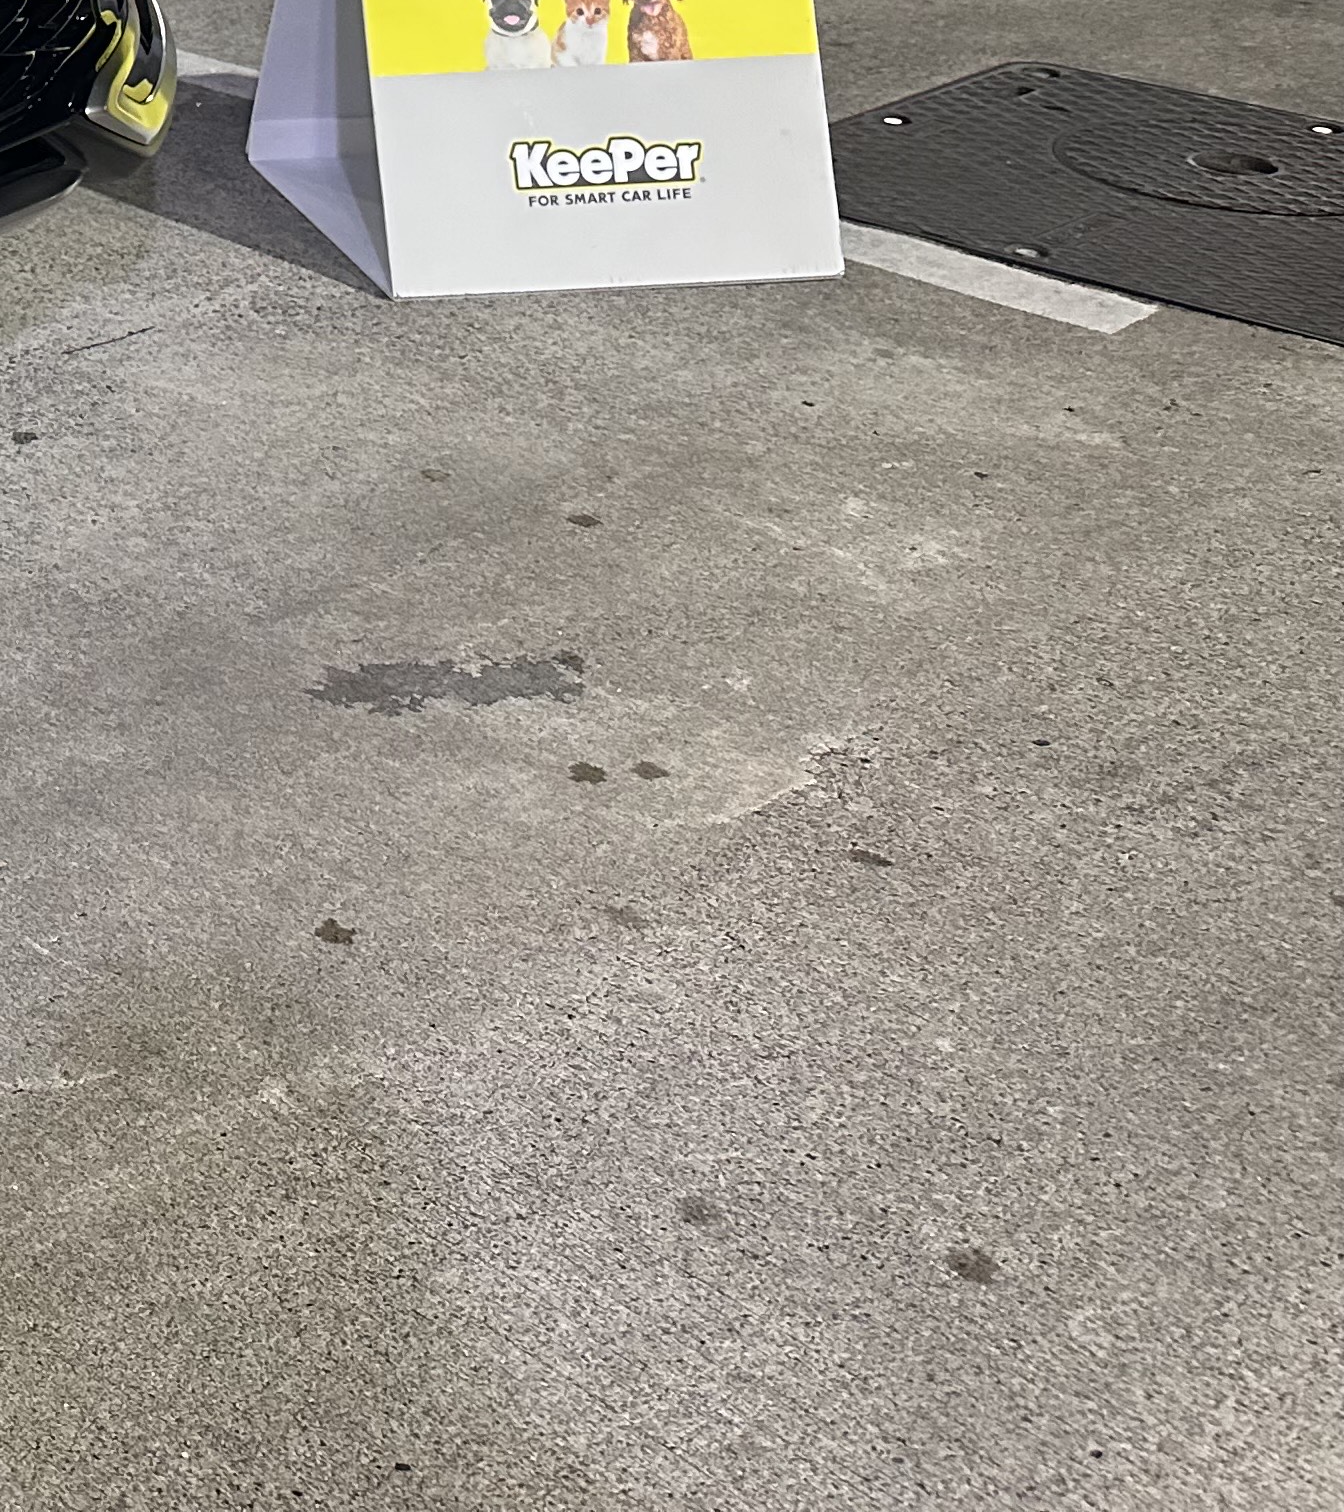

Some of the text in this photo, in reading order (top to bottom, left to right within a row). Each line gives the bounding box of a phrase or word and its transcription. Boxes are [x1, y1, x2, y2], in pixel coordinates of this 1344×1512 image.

[510, 136, 701, 190] KeePer
[528, 187, 692, 208] FOR SMART CAR LIFE
